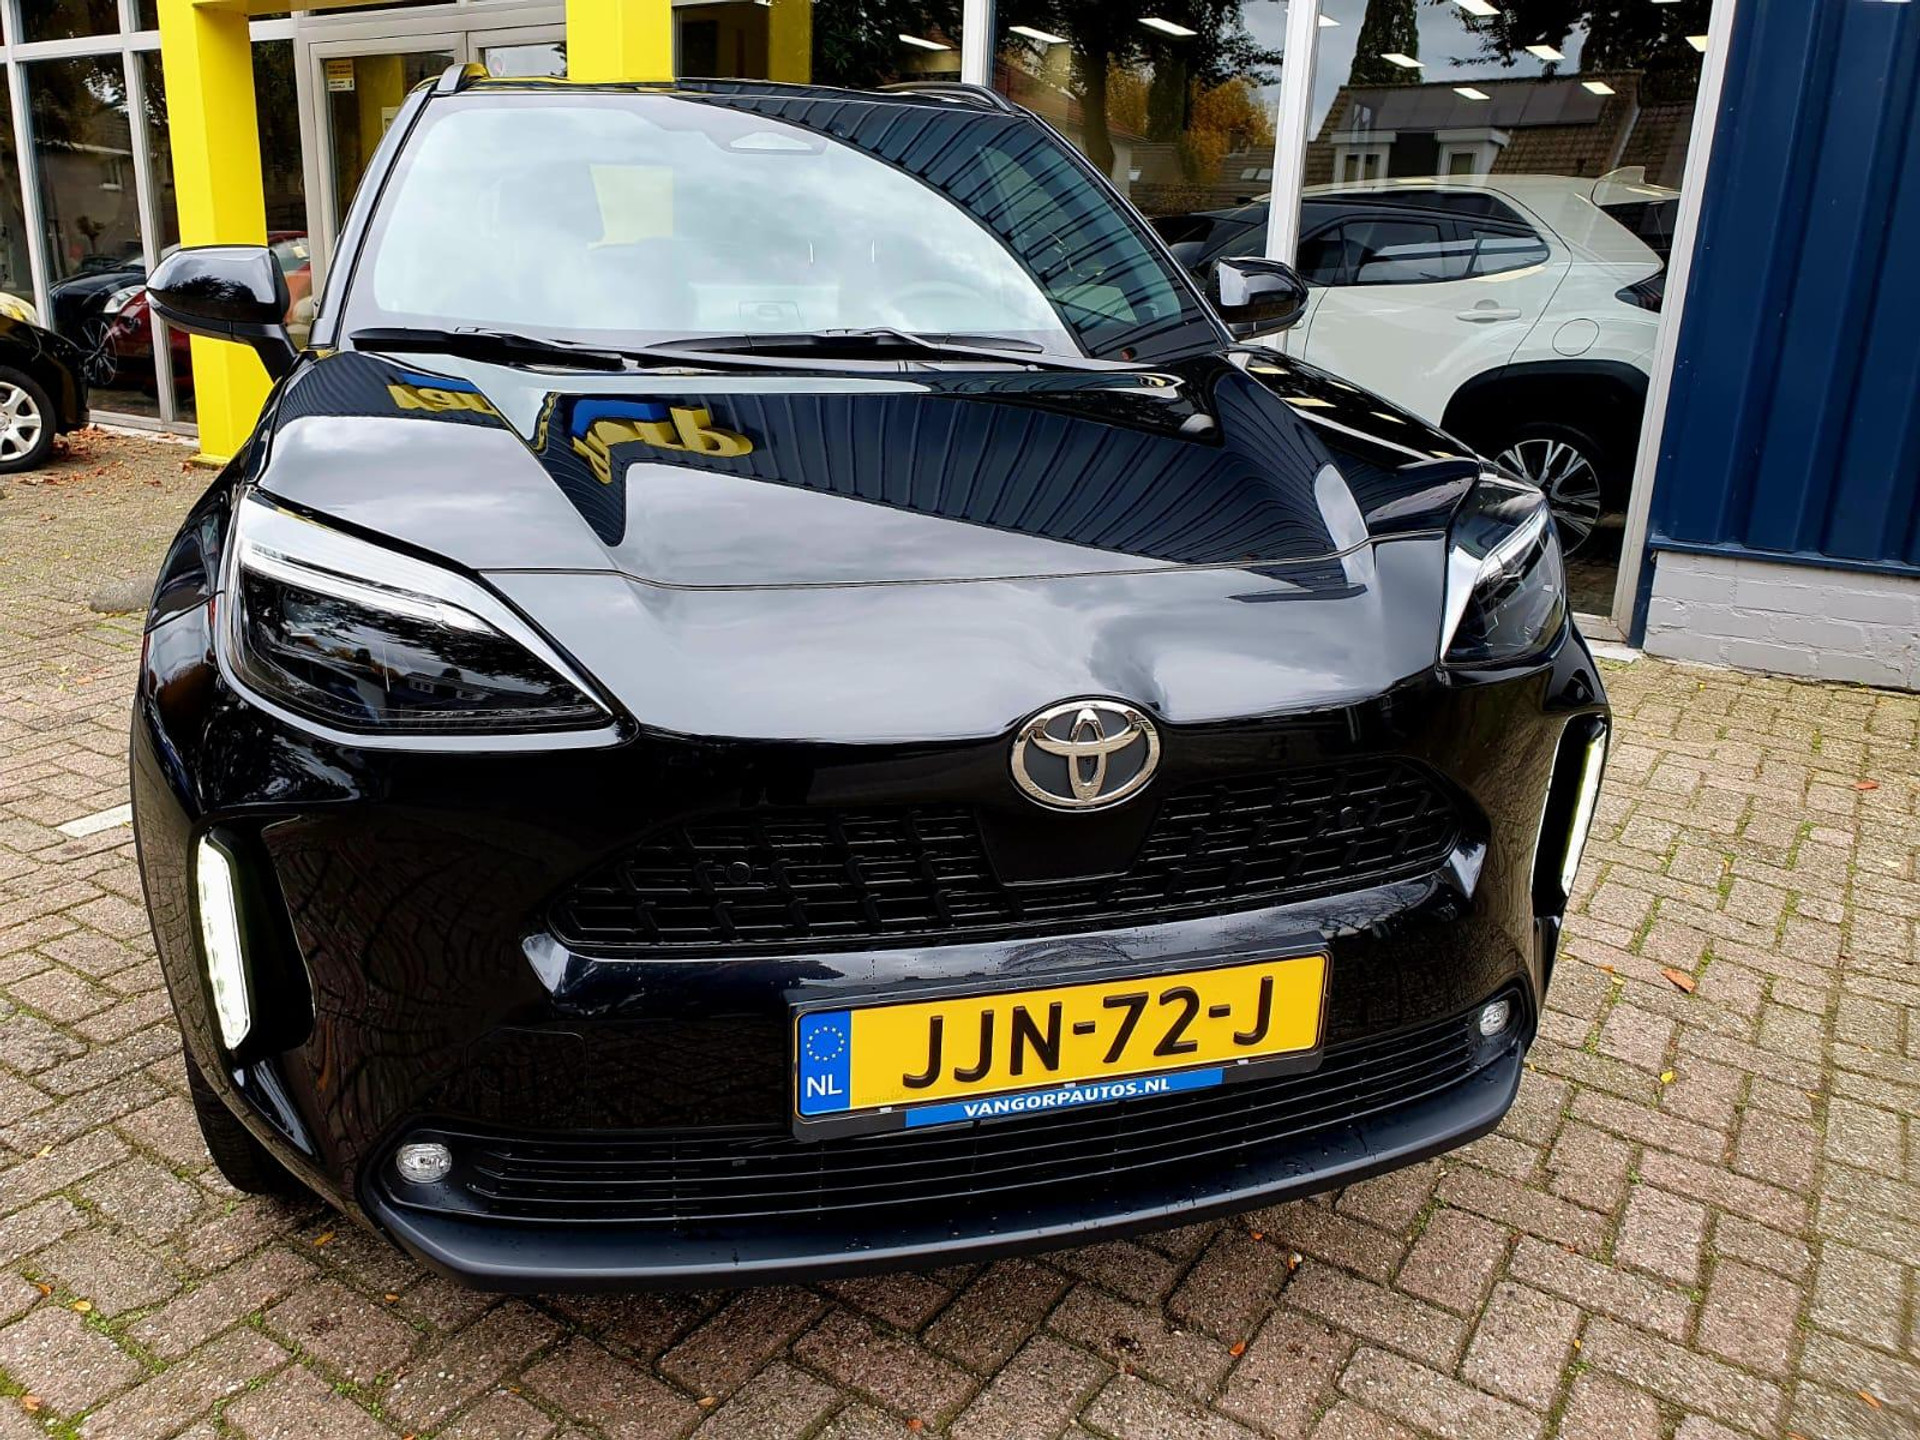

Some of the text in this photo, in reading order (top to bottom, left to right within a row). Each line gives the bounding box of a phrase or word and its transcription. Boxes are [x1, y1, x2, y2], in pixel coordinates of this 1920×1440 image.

[902, 975, 1274, 1089] JJN-72-J
[806, 1073, 843, 1098] NL
[963, 1077, 1171, 1118] VANGORPAUTOS.NL
